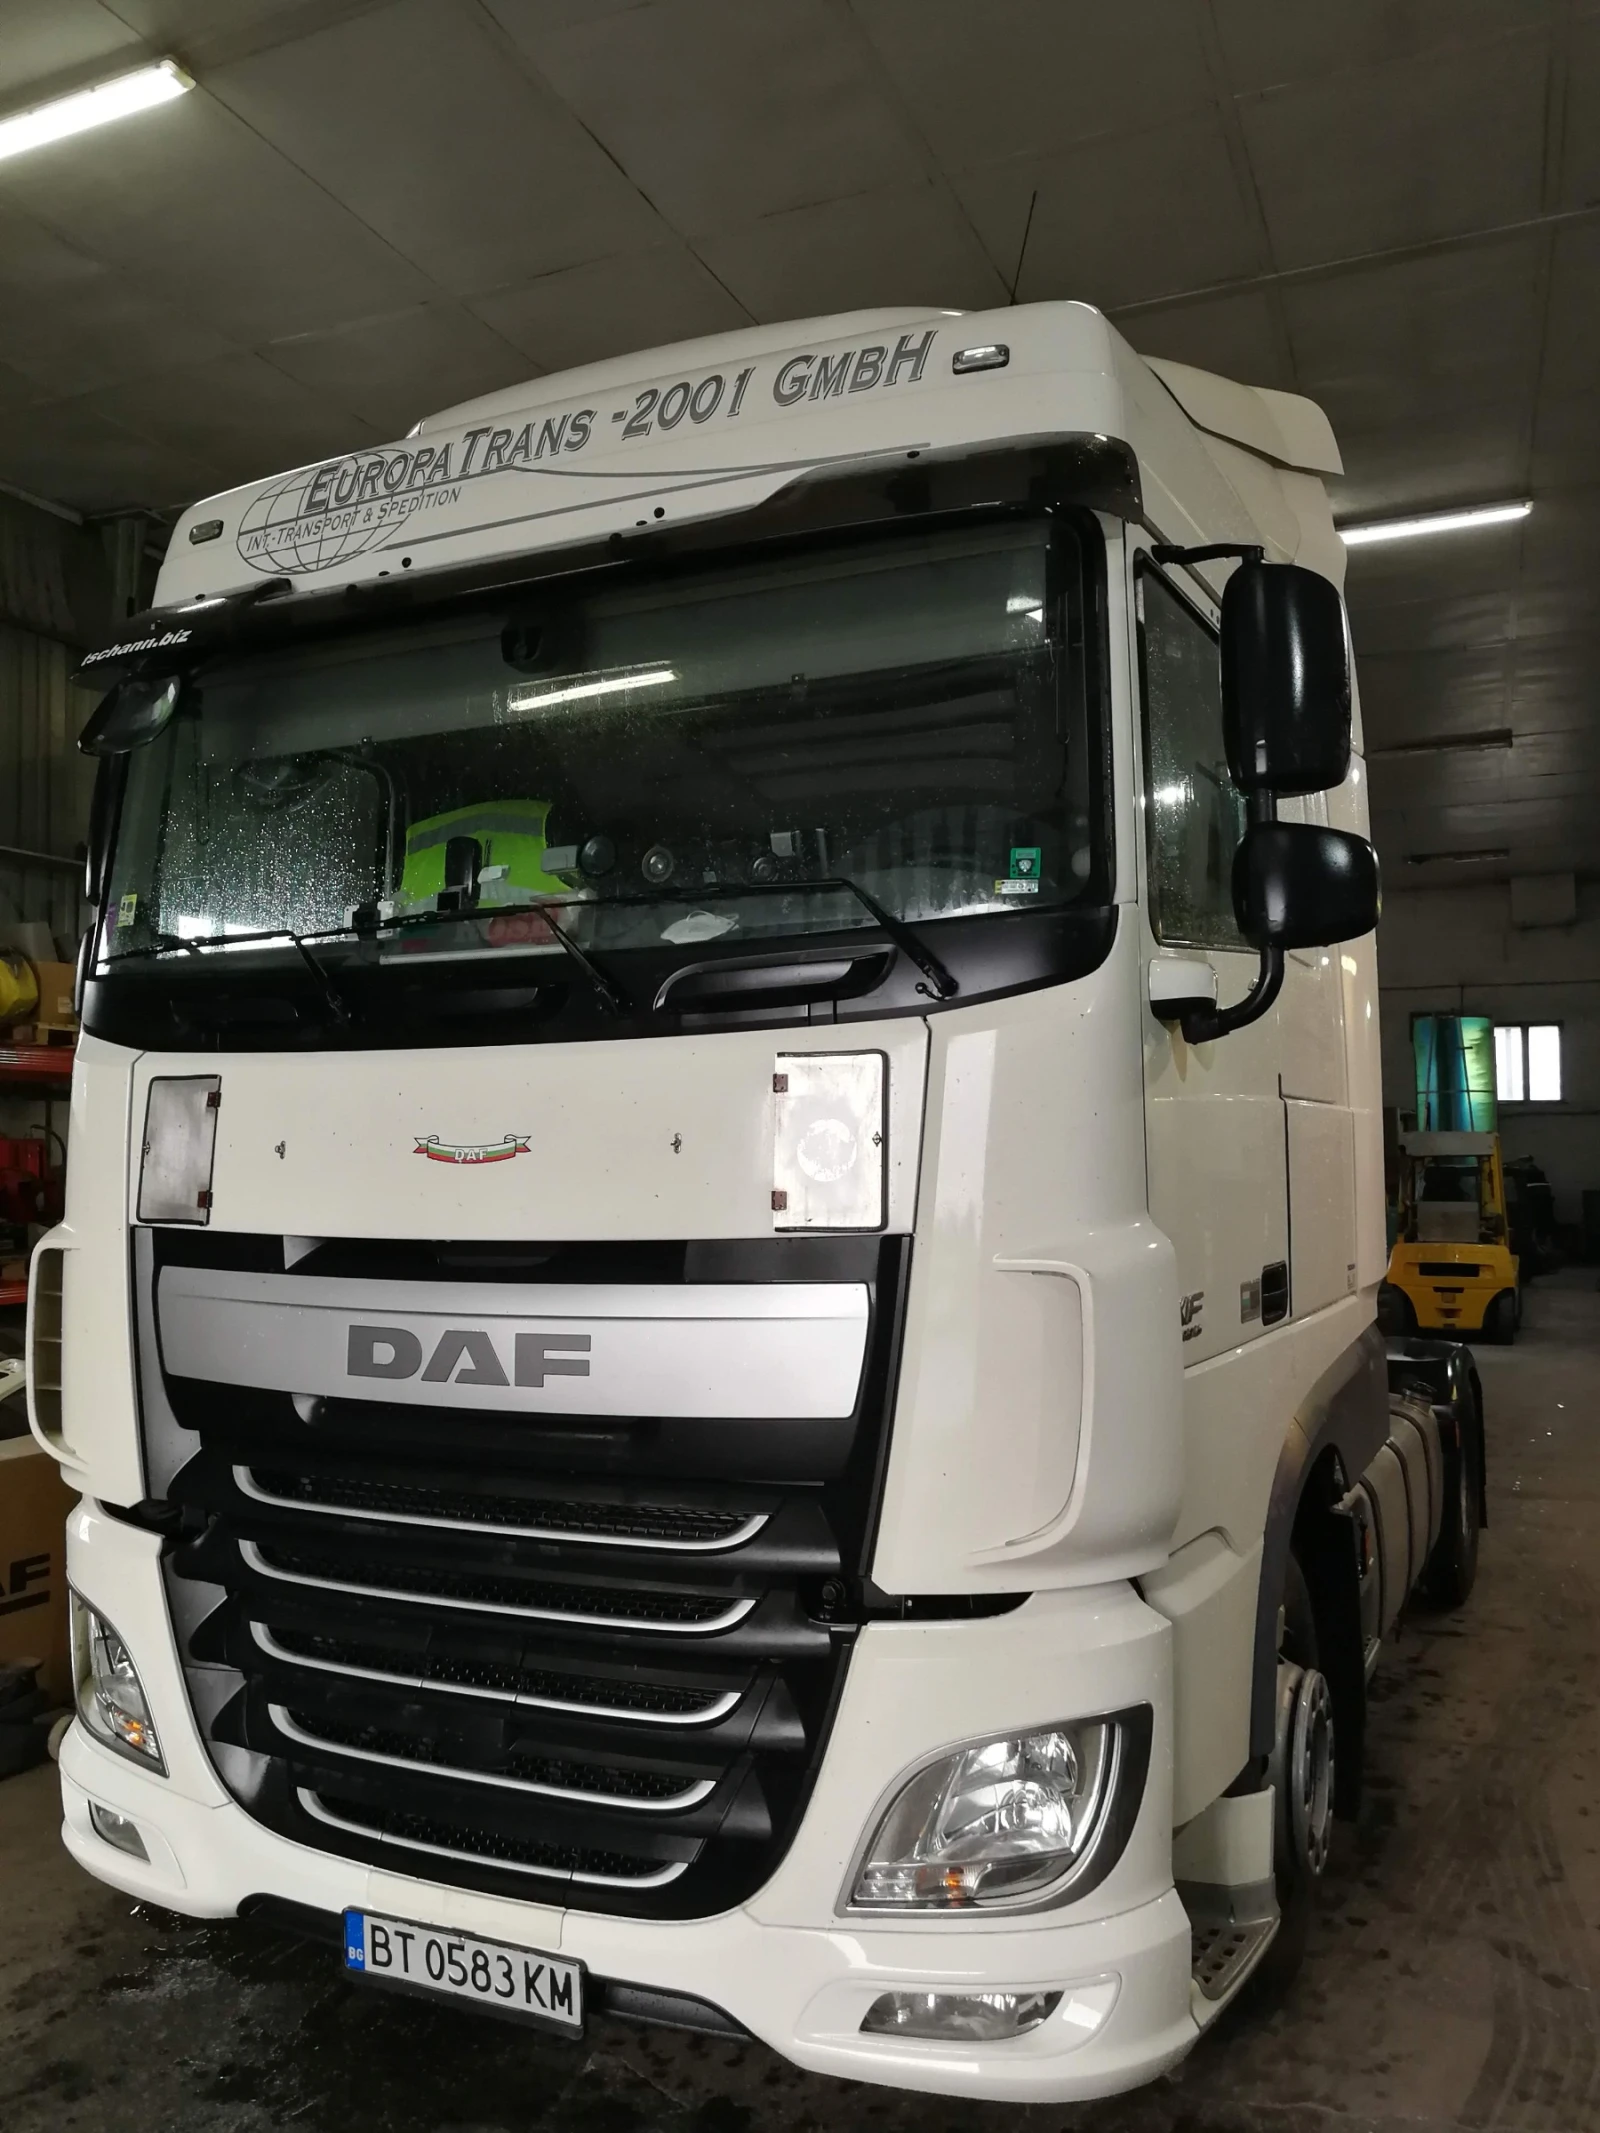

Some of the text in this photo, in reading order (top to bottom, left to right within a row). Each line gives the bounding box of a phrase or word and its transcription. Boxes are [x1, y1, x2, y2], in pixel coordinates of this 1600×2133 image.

[362, 508, 373, 524] &
[377, 486, 462, 520] SPEDITION
[80, 629, 193, 667] tschann.biz
[454, 1147, 489, 1162] DAF
[347, 1325, 592, 1388] DAF
[348, 1946, 364, 1962] BG
[425, 1938, 516, 1999] 0583
[523, 1960, 574, 2016] KM
